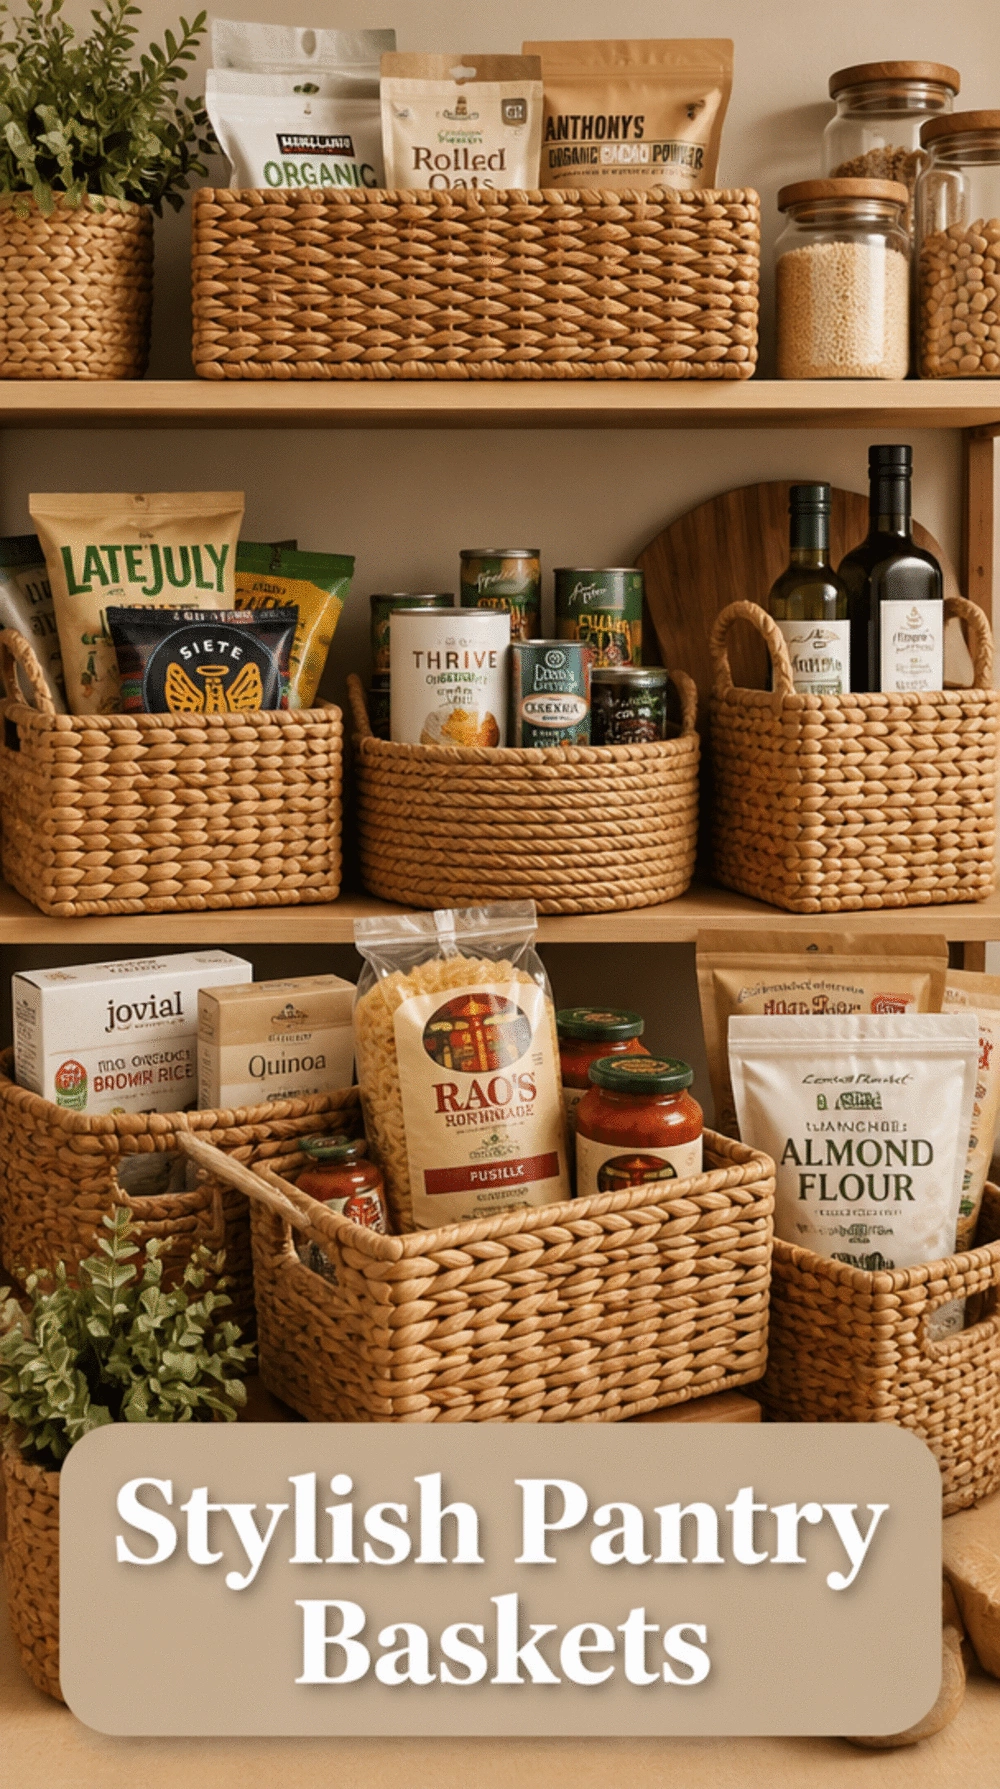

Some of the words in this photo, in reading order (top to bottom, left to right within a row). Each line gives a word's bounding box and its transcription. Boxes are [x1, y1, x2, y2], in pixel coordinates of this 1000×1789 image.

[412, 146, 506, 171] Rolled
[263, 160, 378, 188] ORGANIC
[179, 640, 243, 660] SIETE
[413, 651, 498, 669] THRIVE
[105, 991, 184, 1033] jovial
[158, 1063, 193, 1082] RICE
[249, 1051, 326, 1081] Quinoa
[432, 1072, 537, 1114] RAO'S
[780, 1137, 934, 1167] ALMOND
[798, 1173, 915, 1201] FLOUR
